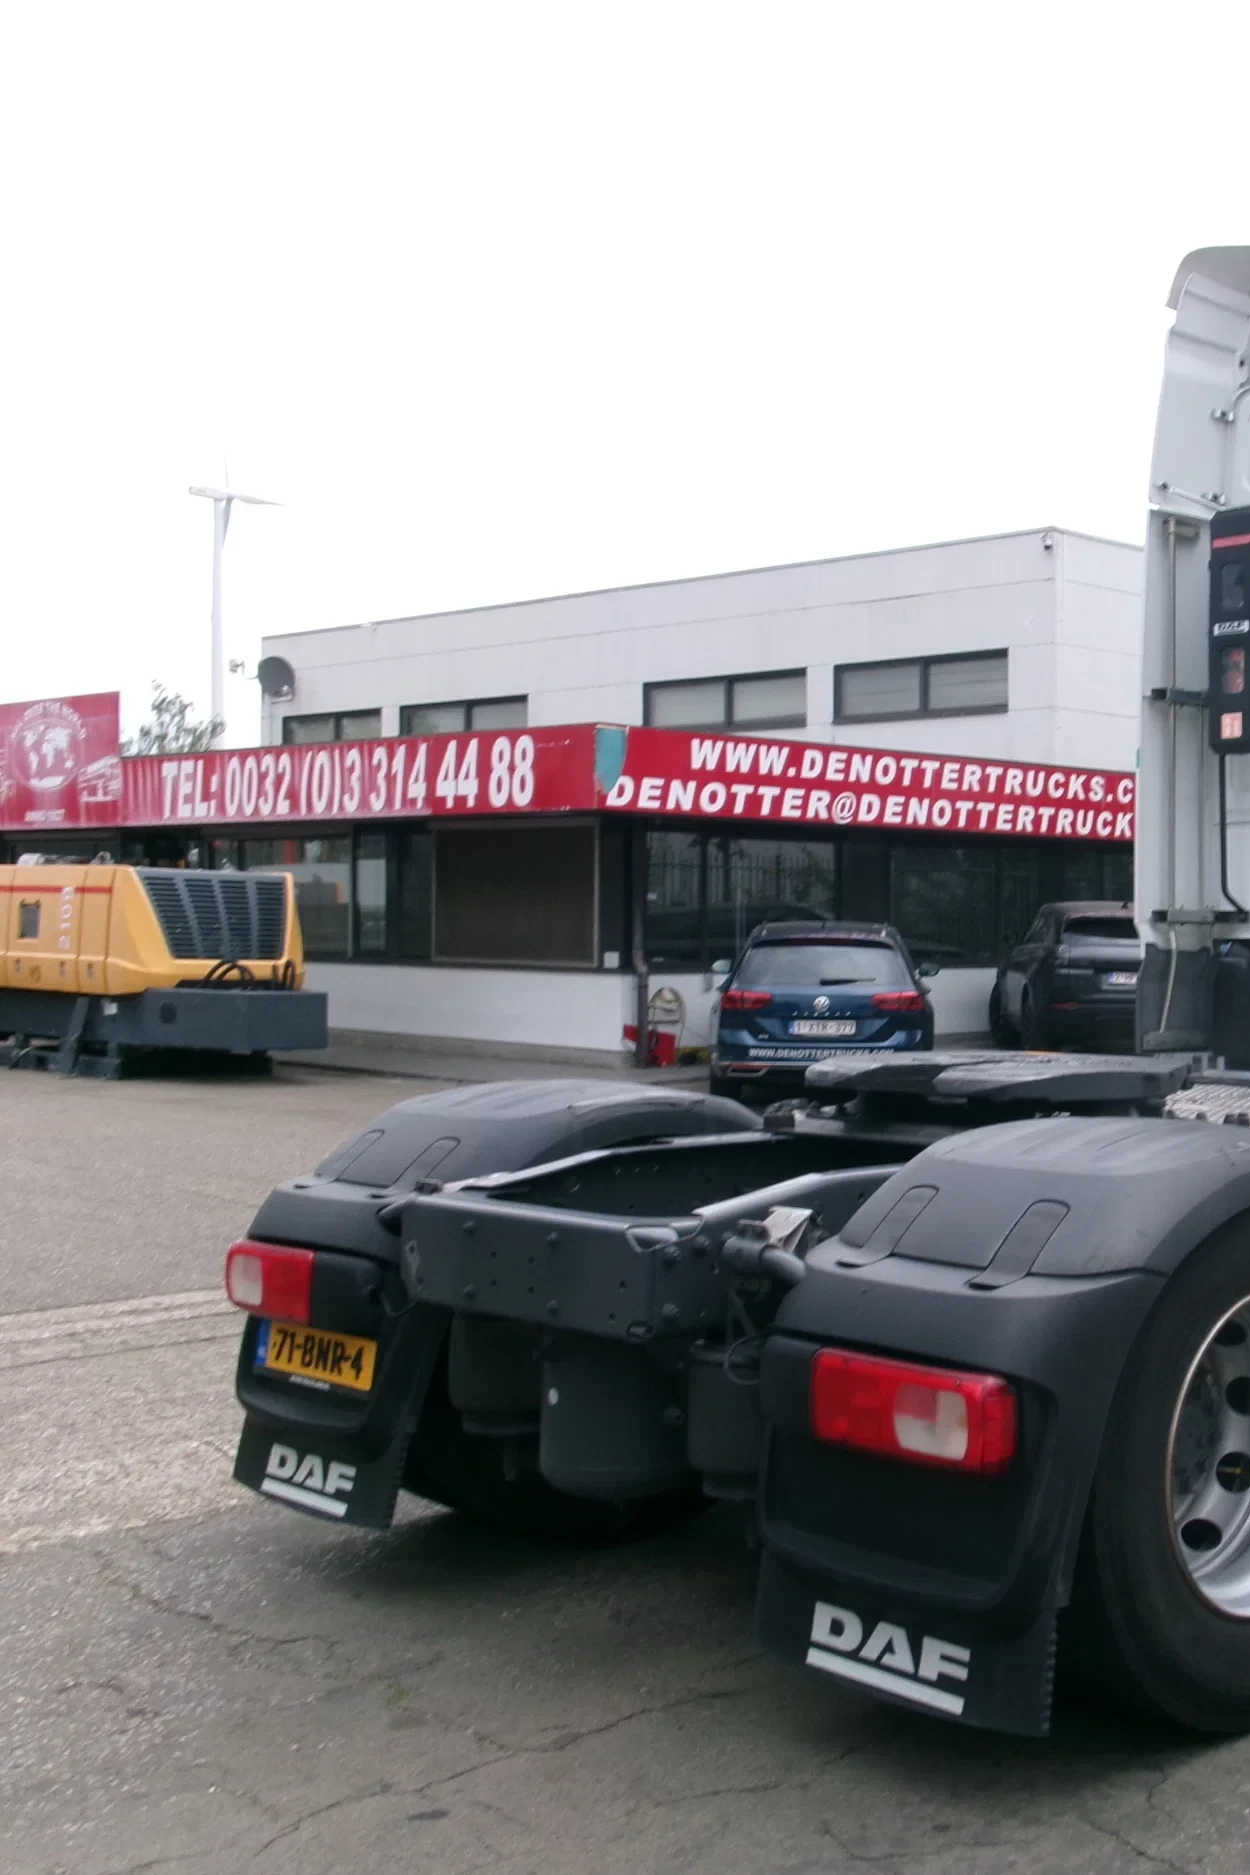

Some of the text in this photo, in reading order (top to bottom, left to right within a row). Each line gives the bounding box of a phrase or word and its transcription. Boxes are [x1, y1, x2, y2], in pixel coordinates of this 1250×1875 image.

[161, 758, 219, 820] TEL:
[225, 752, 292, 817] 0032
[369, 743, 428, 812] 314
[435, 737, 479, 809] 44
[488, 734, 535, 808] 88
[690, 738, 1134, 804] WWW.DENOTTERTRUCKS.C
[605, 775, 1134, 838] DENOTTER@DENOTTERTRUCK
[274, 1327, 365, 1381] 71-BNR-4
[265, 1441, 357, 1495] DAF
[810, 1600, 972, 1683] DAF
